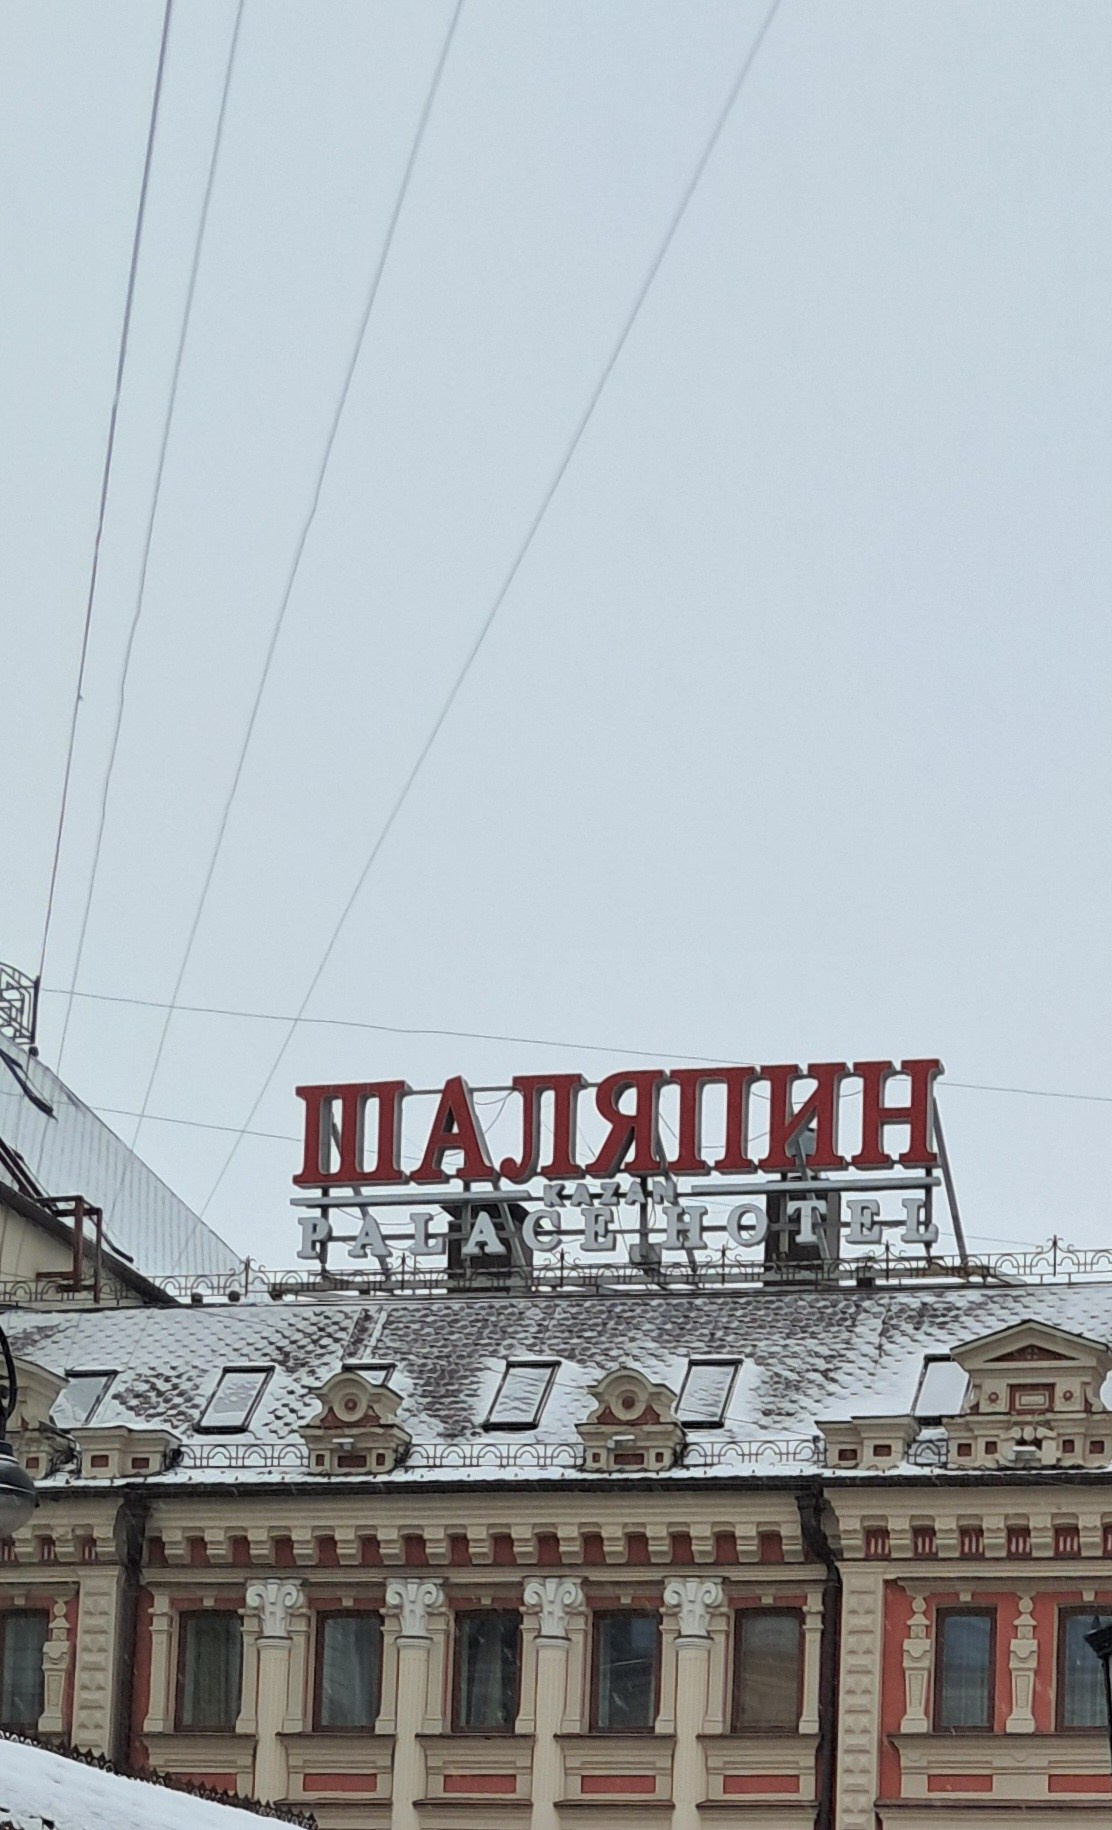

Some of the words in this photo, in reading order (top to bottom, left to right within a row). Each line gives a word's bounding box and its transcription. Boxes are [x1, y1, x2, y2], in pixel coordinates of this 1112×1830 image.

[293, 1058, 944, 1187] ШАЛЯПИН
[543, 1178, 679, 1208] KAZAN
[297, 1206, 617, 1260] PALACE
[661, 1197, 939, 1251] HOTEL
